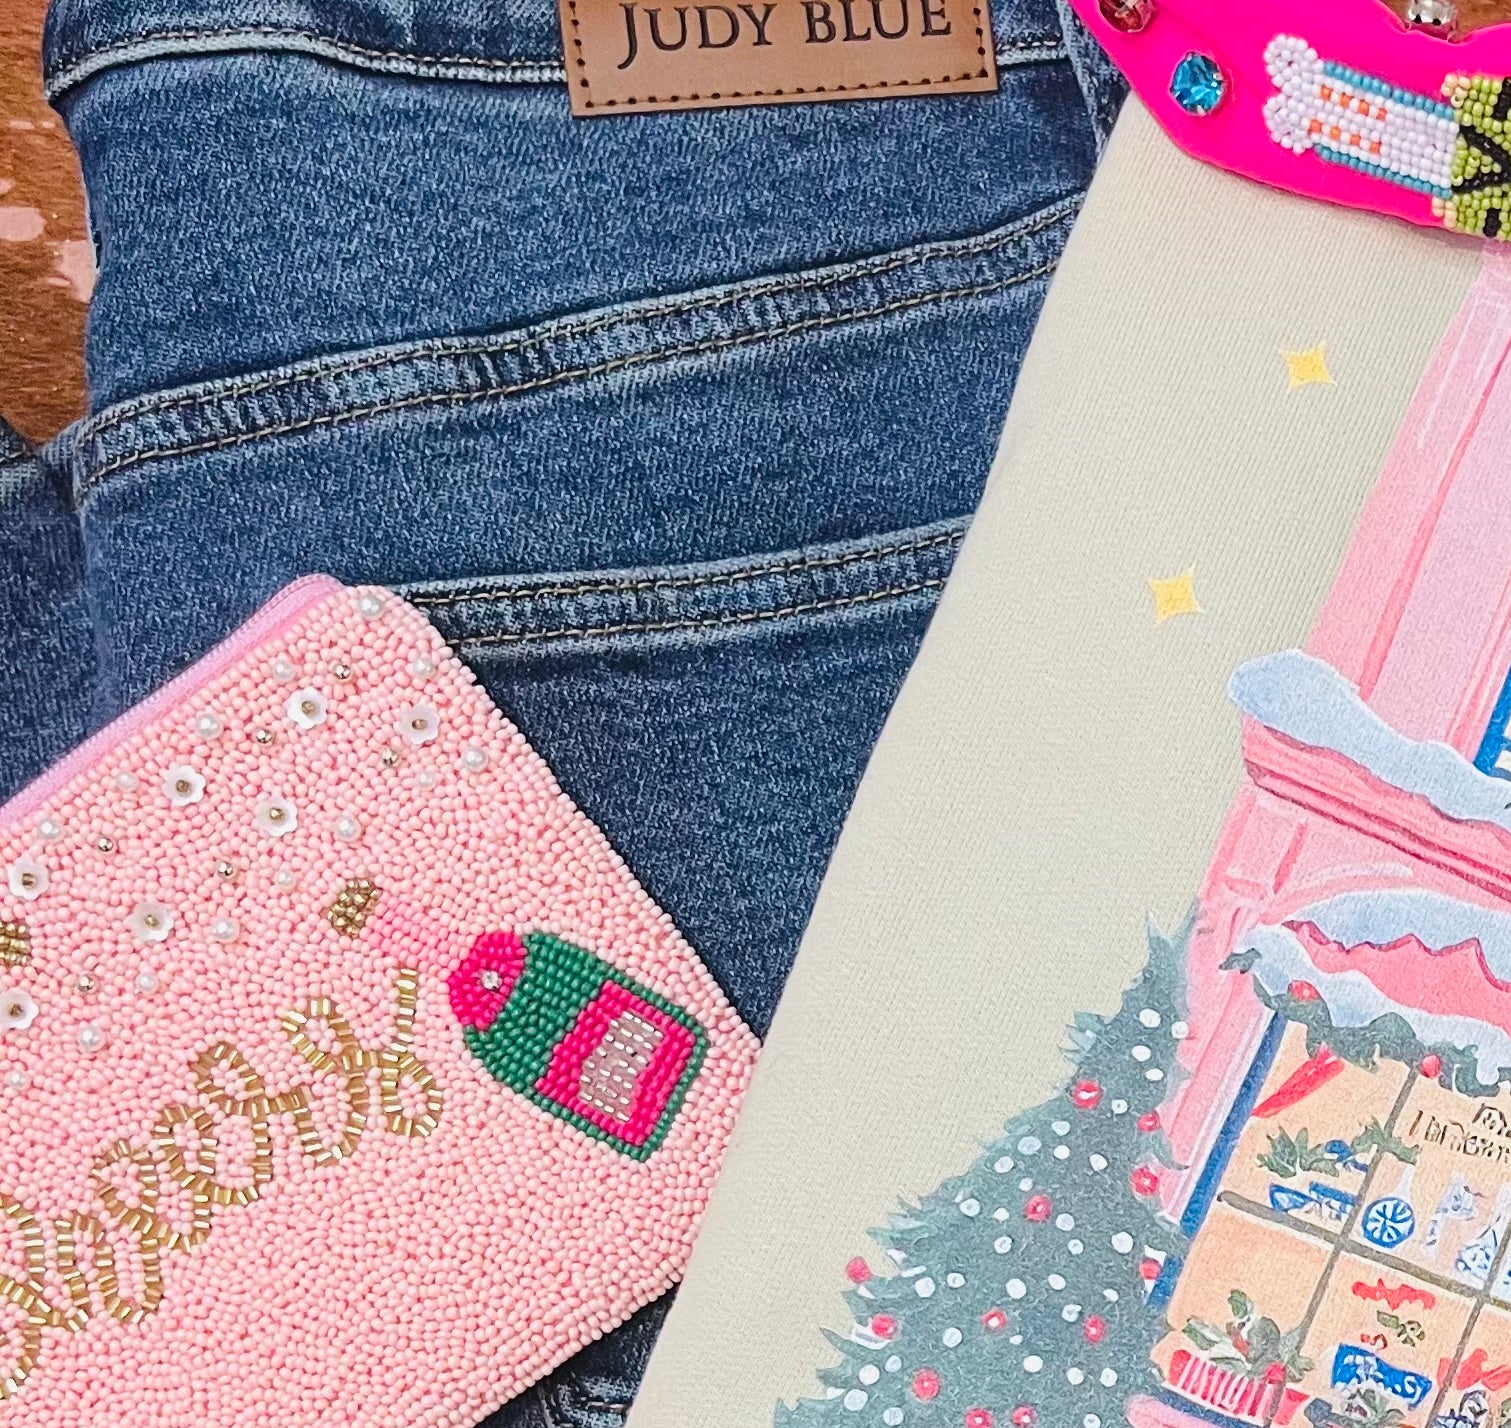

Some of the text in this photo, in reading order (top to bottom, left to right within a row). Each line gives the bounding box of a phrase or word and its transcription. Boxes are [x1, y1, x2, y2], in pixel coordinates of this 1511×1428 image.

[616, 0, 953, 70] JUDY BLUE
[0, 966, 444, 1399] heers
